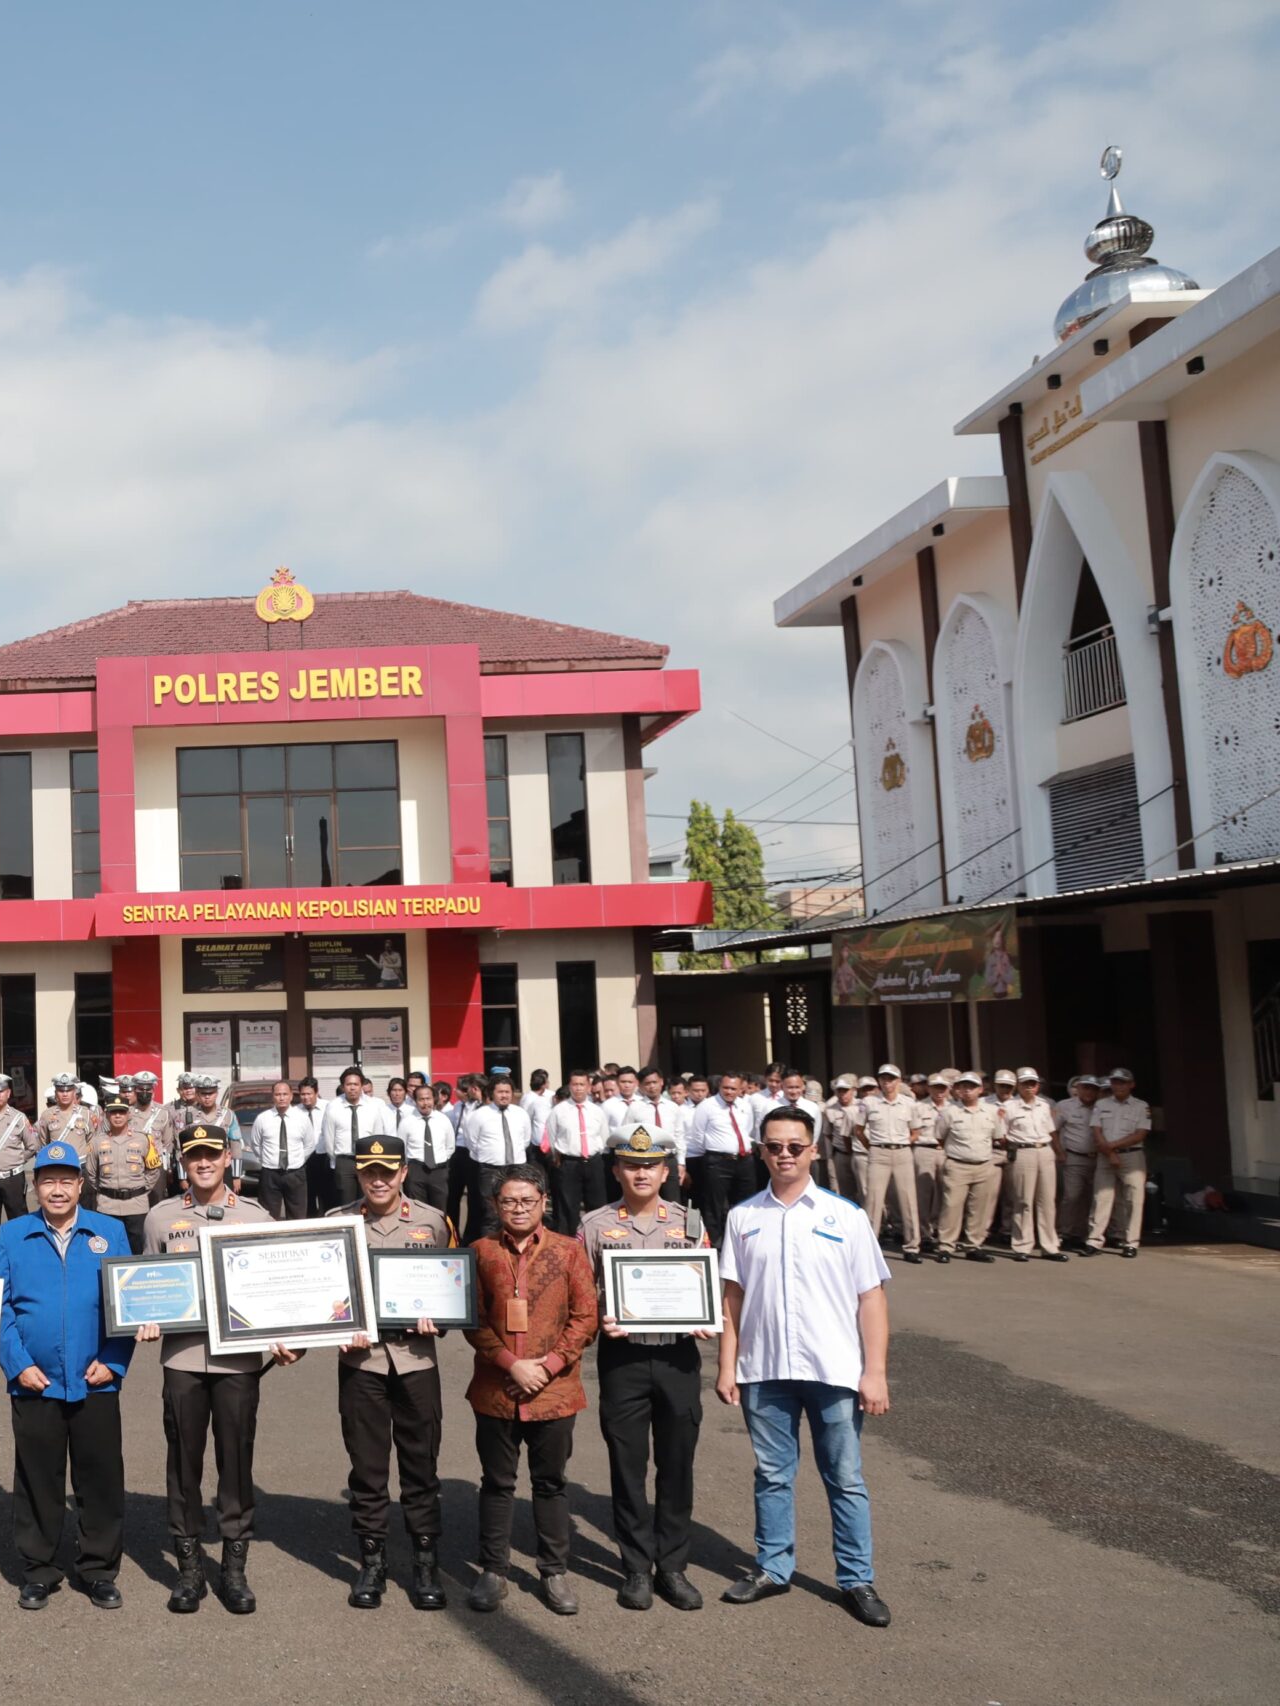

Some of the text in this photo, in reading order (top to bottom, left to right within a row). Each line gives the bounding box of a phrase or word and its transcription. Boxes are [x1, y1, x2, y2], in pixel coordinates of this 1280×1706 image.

[153, 665, 424, 705] POLRES JEMBER
[122, 897, 481, 923] SENTRA PELAYANAN KEPOLISIAN TERPADU
[195, 943, 271, 952] SELAMAT DATANG
[168, 1230, 195, 1240] BAYU
[258, 1248, 310, 1260] SERTIFIKAT
